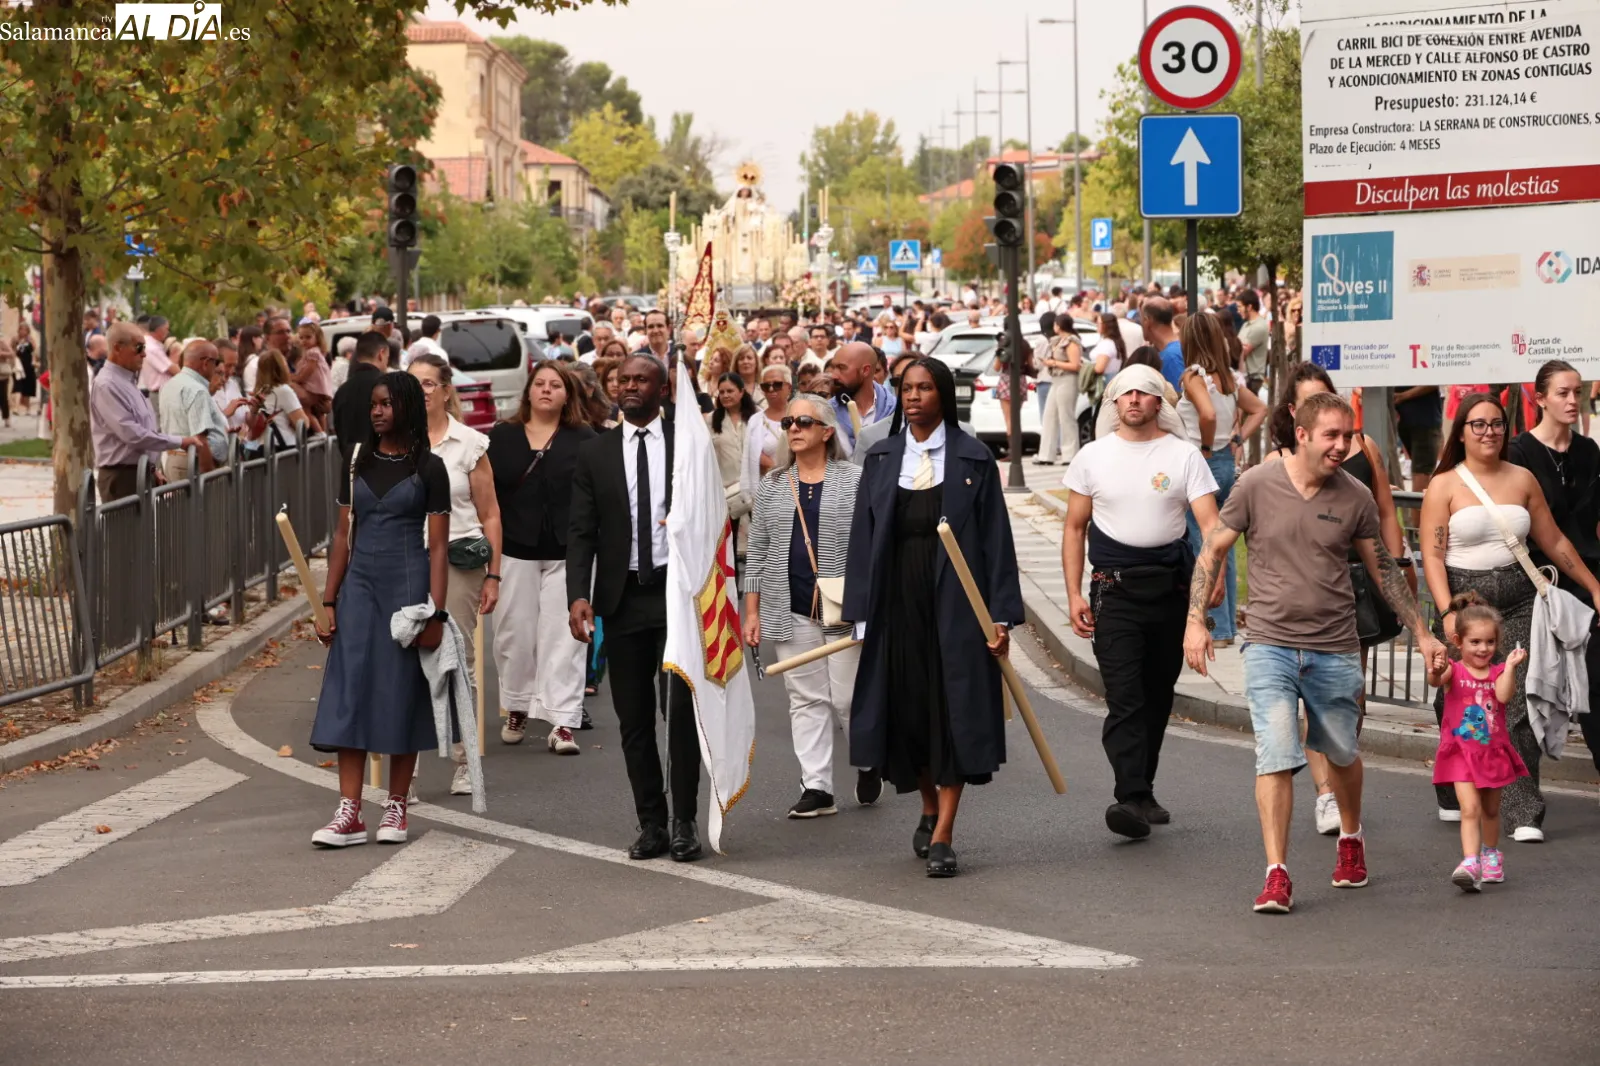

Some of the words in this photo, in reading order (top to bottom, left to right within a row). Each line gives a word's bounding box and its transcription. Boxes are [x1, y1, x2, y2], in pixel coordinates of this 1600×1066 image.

[1337, 37, 1377, 51] CARRIL
[1381, 35, 1403, 49] BICI
[1407, 34, 1423, 47] DE
[1426, 33, 1484, 47] CONEXIÓN
[1488, 31, 1526, 46] ENTRE
[1530, 24, 1582, 42] AVENIDA
[1161, 41, 1218, 74] 30
[1330, 57, 1345, 70] DE
[1348, 56, 1362, 69] LA
[1366, 53, 1411, 68] MERCED
[1415, 52, 1422, 65] Y
[1426, 51, 1461, 64] CALLE
[1465, 49, 1519, 64] ALFONSO
[1523, 47, 1539, 61] DE
[1543, 42, 1591, 59] CASTRO
[1328, 76, 1335, 88] Y
[1338, 69, 1458, 88] ACONDICIONAMIENTO
[1462, 69, 1477, 82] EN
[1481, 67, 1520, 82] ZONAS
[1524, 62, 1592, 79] CONTIGUAS
[1375, 93, 1459, 113] Presupuesto:
[1465, 92, 1527, 107] 231.124,14
[1530, 91, 1538, 104] €
[1309, 124, 1349, 138] Empresa
[1352, 122, 1415, 135] Constructora:
[1419, 119, 1431, 132] LA
[1434, 118, 1480, 131] SERRANA
[1483, 117, 1496, 129] DE
[1499, 113, 1592, 129] CONSTRUCCIONES,
[1309, 142, 1334, 154] Plazo
[1336, 142, 1347, 153] de
[1350, 140, 1396, 155] Ejecución:
[1399, 140, 1406, 150] 4
[1408, 138, 1441, 150] MESES
[1355, 178, 1439, 210] Disculpen
[1446, 175, 1470, 200] las
[1476, 172, 1560, 198] molestias
[1094, 222, 1108, 247] P
[1528, 337, 1550, 345] Junta
[1551, 337, 1561, 345] de
[1528, 347, 1555, 355] Castilla
[1557, 348, 1562, 356] y
[1563, 346, 1583, 354] León
